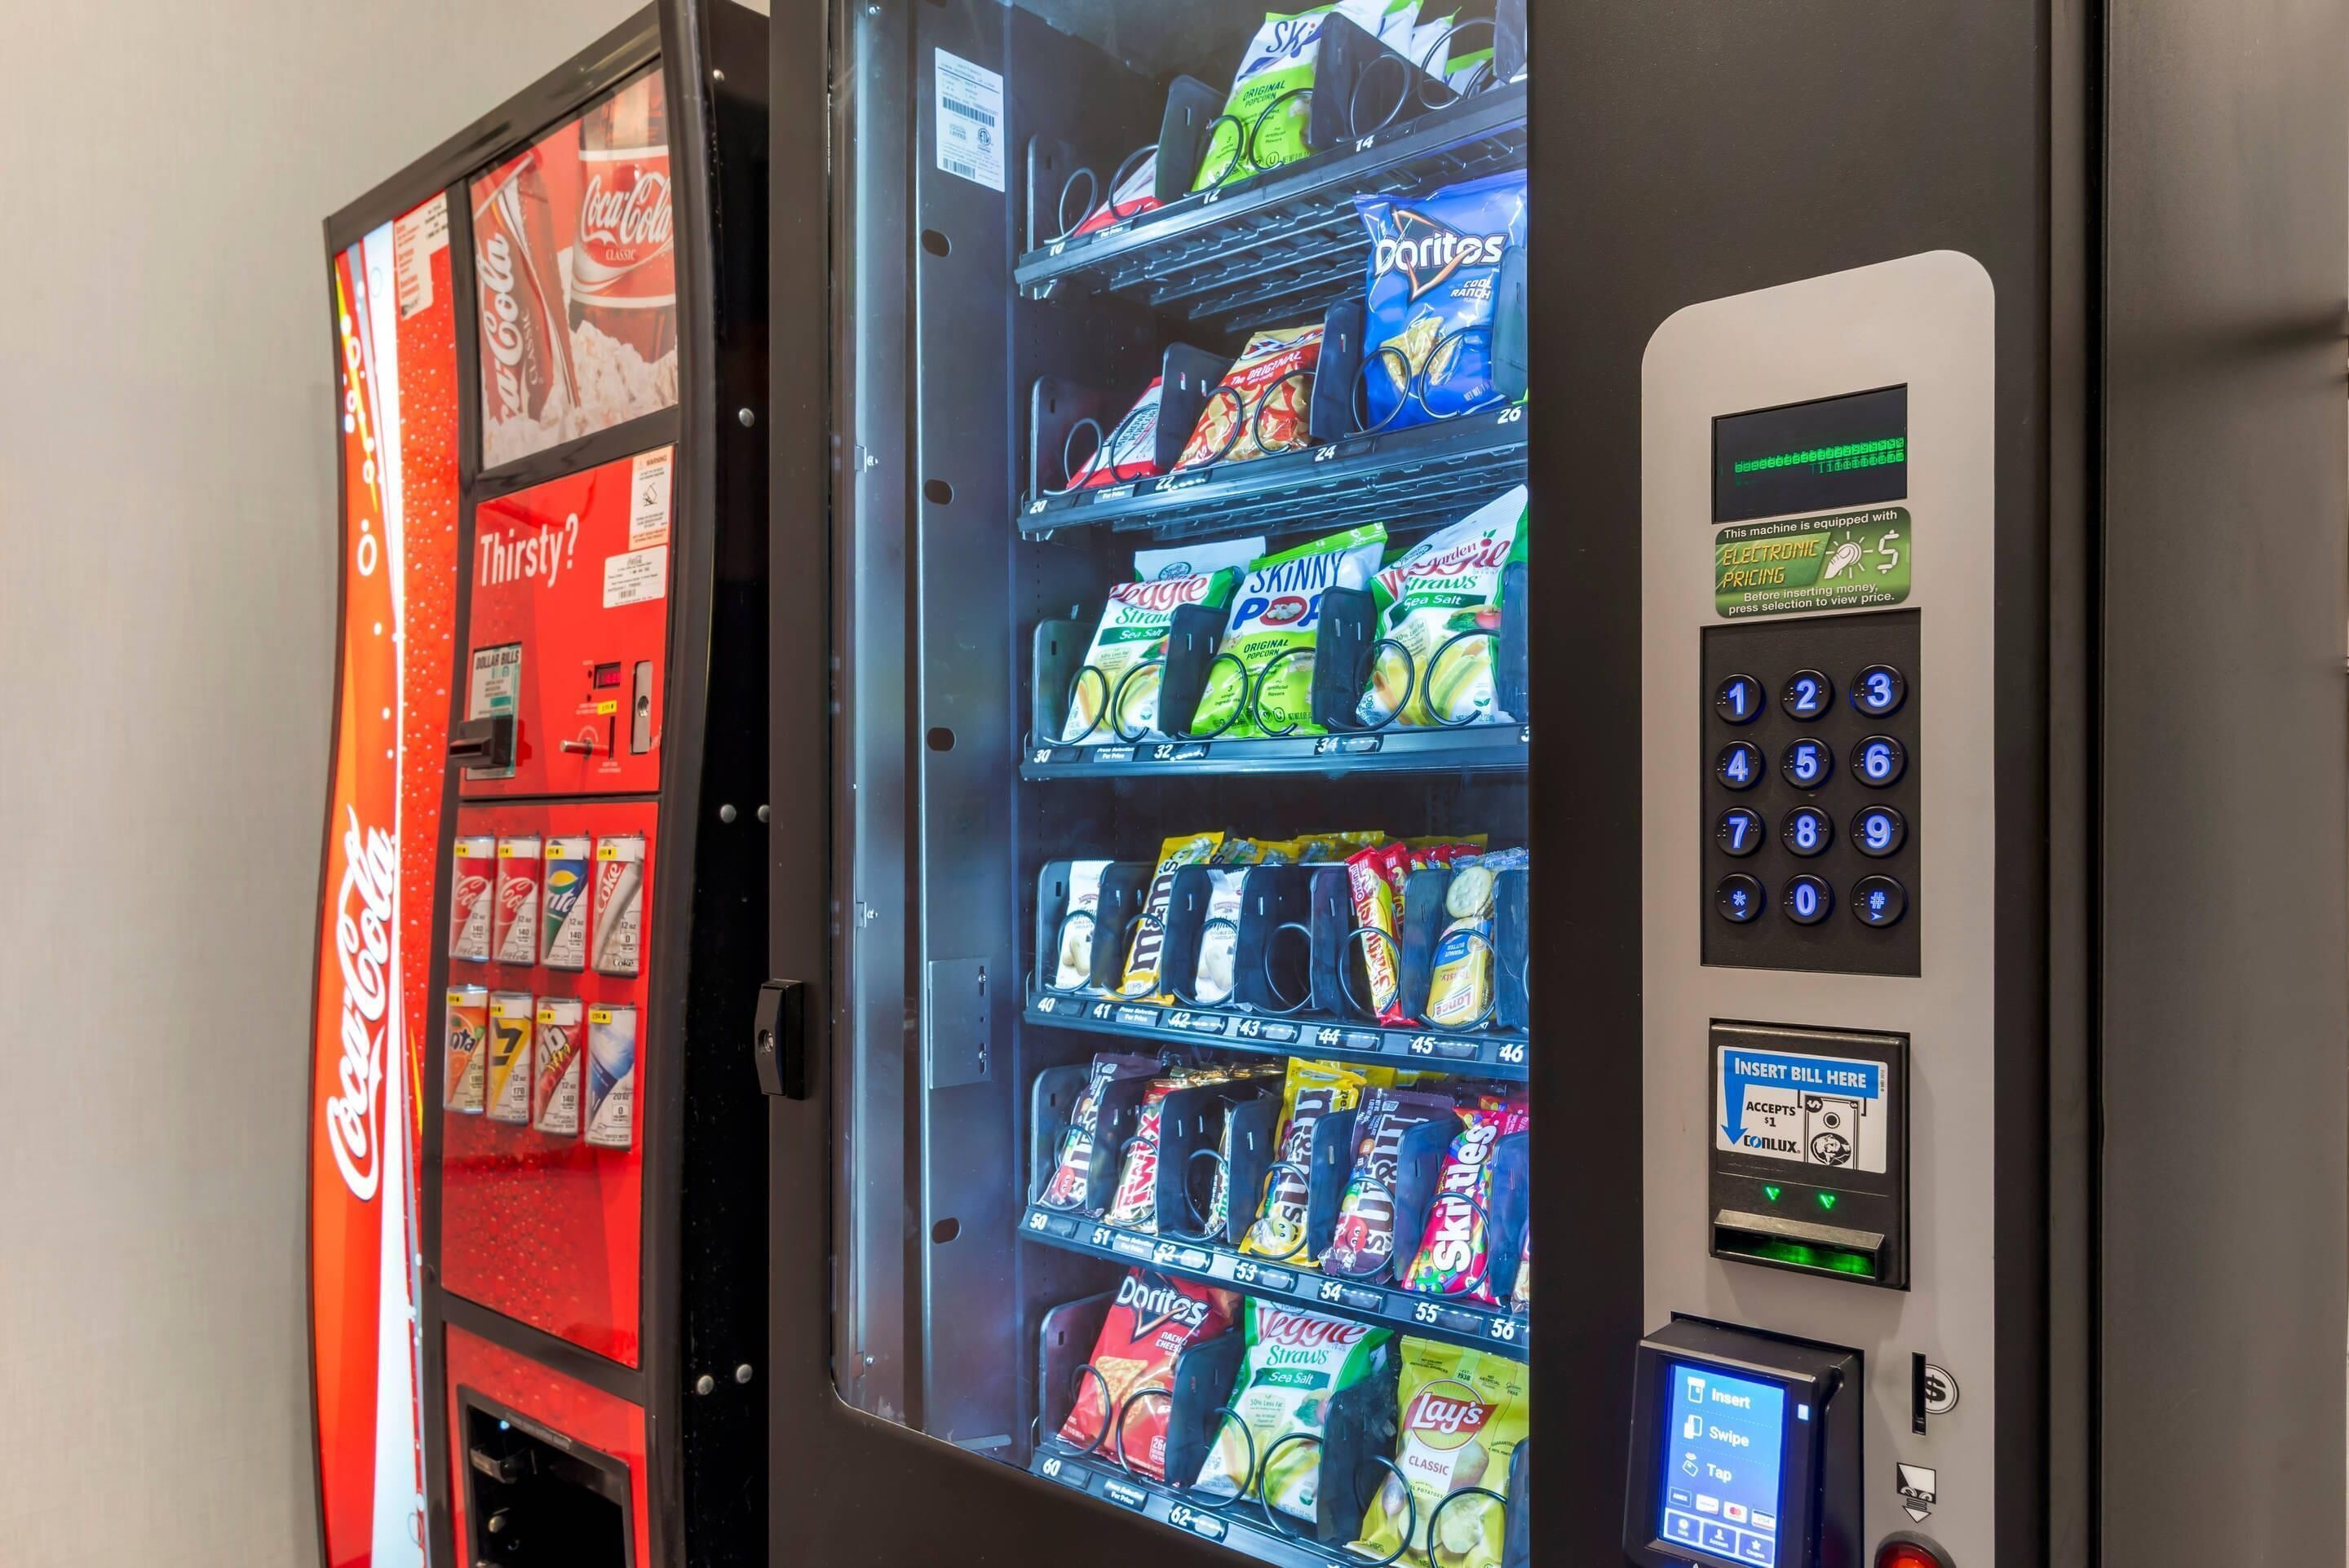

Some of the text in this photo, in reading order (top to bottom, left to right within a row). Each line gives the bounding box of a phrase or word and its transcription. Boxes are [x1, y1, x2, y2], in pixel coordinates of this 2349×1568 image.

[1243, 80, 1285, 101] ORIGINAL
[1245, 93, 1276, 108] POPCORN
[1356, 135, 1375, 152] 14
[1203, 188, 1221, 204] 12
[605, 249, 636, 260] CLASSIC
[1049, 242, 1066, 257] 10
[1375, 232, 1509, 276] Doritos
[1462, 279, 1492, 289] COOL
[1450, 288, 1492, 300] RANCH
[1247, 351, 1303, 383] ORIGINAL
[1497, 406, 1521, 424] 26
[1315, 445, 1338, 462] 24
[1155, 476, 1175, 490] 22
[1029, 500, 1047, 515] 20
[1724, 510, 1898, 539] This machine is equipped with
[480, 512, 578, 588] Thirsty?
[1428, 541, 1476, 568] garden
[1723, 539, 1820, 566] ELECTRONIC
[1723, 567, 1786, 589] PRICING
[1744, 582, 1878, 603] Before inserting money,
[1404, 594, 1462, 611] Sea Salt
[1728, 591, 1895, 616] press selection to view price.
[1120, 628, 1163, 640] Sea Salt
[1244, 639, 1289, 653] ORIGINAL
[1246, 649, 1280, 660] POPCORN
[476, 650, 520, 669] DOLLAR BILLS
[1728, 682, 1745, 715] 1
[1796, 678, 1817, 711] 2
[1866, 672, 1892, 708] 3
[1154, 744, 1174, 759] 32
[1317, 737, 1338, 753] 34
[1033, 749, 1051, 763] 30
[1727, 749, 1749, 782] 4
[1795, 745, 1818, 780] 5
[1865, 742, 1891, 779] 6
[1728, 816, 1749, 849] 7
[1796, 815, 1817, 849] 8
[1865, 815, 1891, 849] 9
[596, 863, 622, 914] Coke
[1351, 864, 1365, 902] Original
[1796, 883, 1817, 917] 0
[1444, 949, 1464, 957] PEANUT
[327, 804, 396, 1202] Coca-Cola
[1037, 997, 1056, 1013] 40
[1093, 1004, 1111, 1018] 41
[1436, 992, 1471, 1016] Lance
[1169, 1012, 1190, 1029] 42
[1240, 1020, 1261, 1036] 43
[1319, 1029, 1340, 1045] 44
[1412, 1036, 1436, 1053] 45
[1500, 1045, 1524, 1062] 46
[1735, 1057, 1867, 1089] INSERT BILL HERE
[1746, 1101, 1796, 1116] ACCEPTS
[1764, 1116, 1776, 1128] $1
[1030, 1213, 1048, 1230] 50
[1093, 1228, 1109, 1245] 51
[1157, 1243, 1177, 1261] 52
[1236, 1262, 1256, 1281] 53
[1116, 1274, 1210, 1327] Doritos
[1320, 1281, 1341, 1301] 54
[1415, 1302, 1439, 1323] 55
[1258, 1307, 1368, 1347] Veggie
[1491, 1318, 1515, 1340] 56
[1266, 1345, 1330, 1366] Straws
[1268, 1371, 1314, 1385] Sea Salt
[1458, 1373, 1471, 1381] 1938
[1712, 1388, 1751, 1410] Insert
[1412, 1392, 1484, 1434] Lay's
[1709, 1426, 1750, 1448] Swipe
[1042, 1460, 1060, 1477] 60
[1409, 1455, 1449, 1476] CLASSIC
[1706, 1463, 1732, 1483] Tap
[1121, 1495, 1135, 1505] Price
[1417, 1486, 1443, 1500] POTATOES
